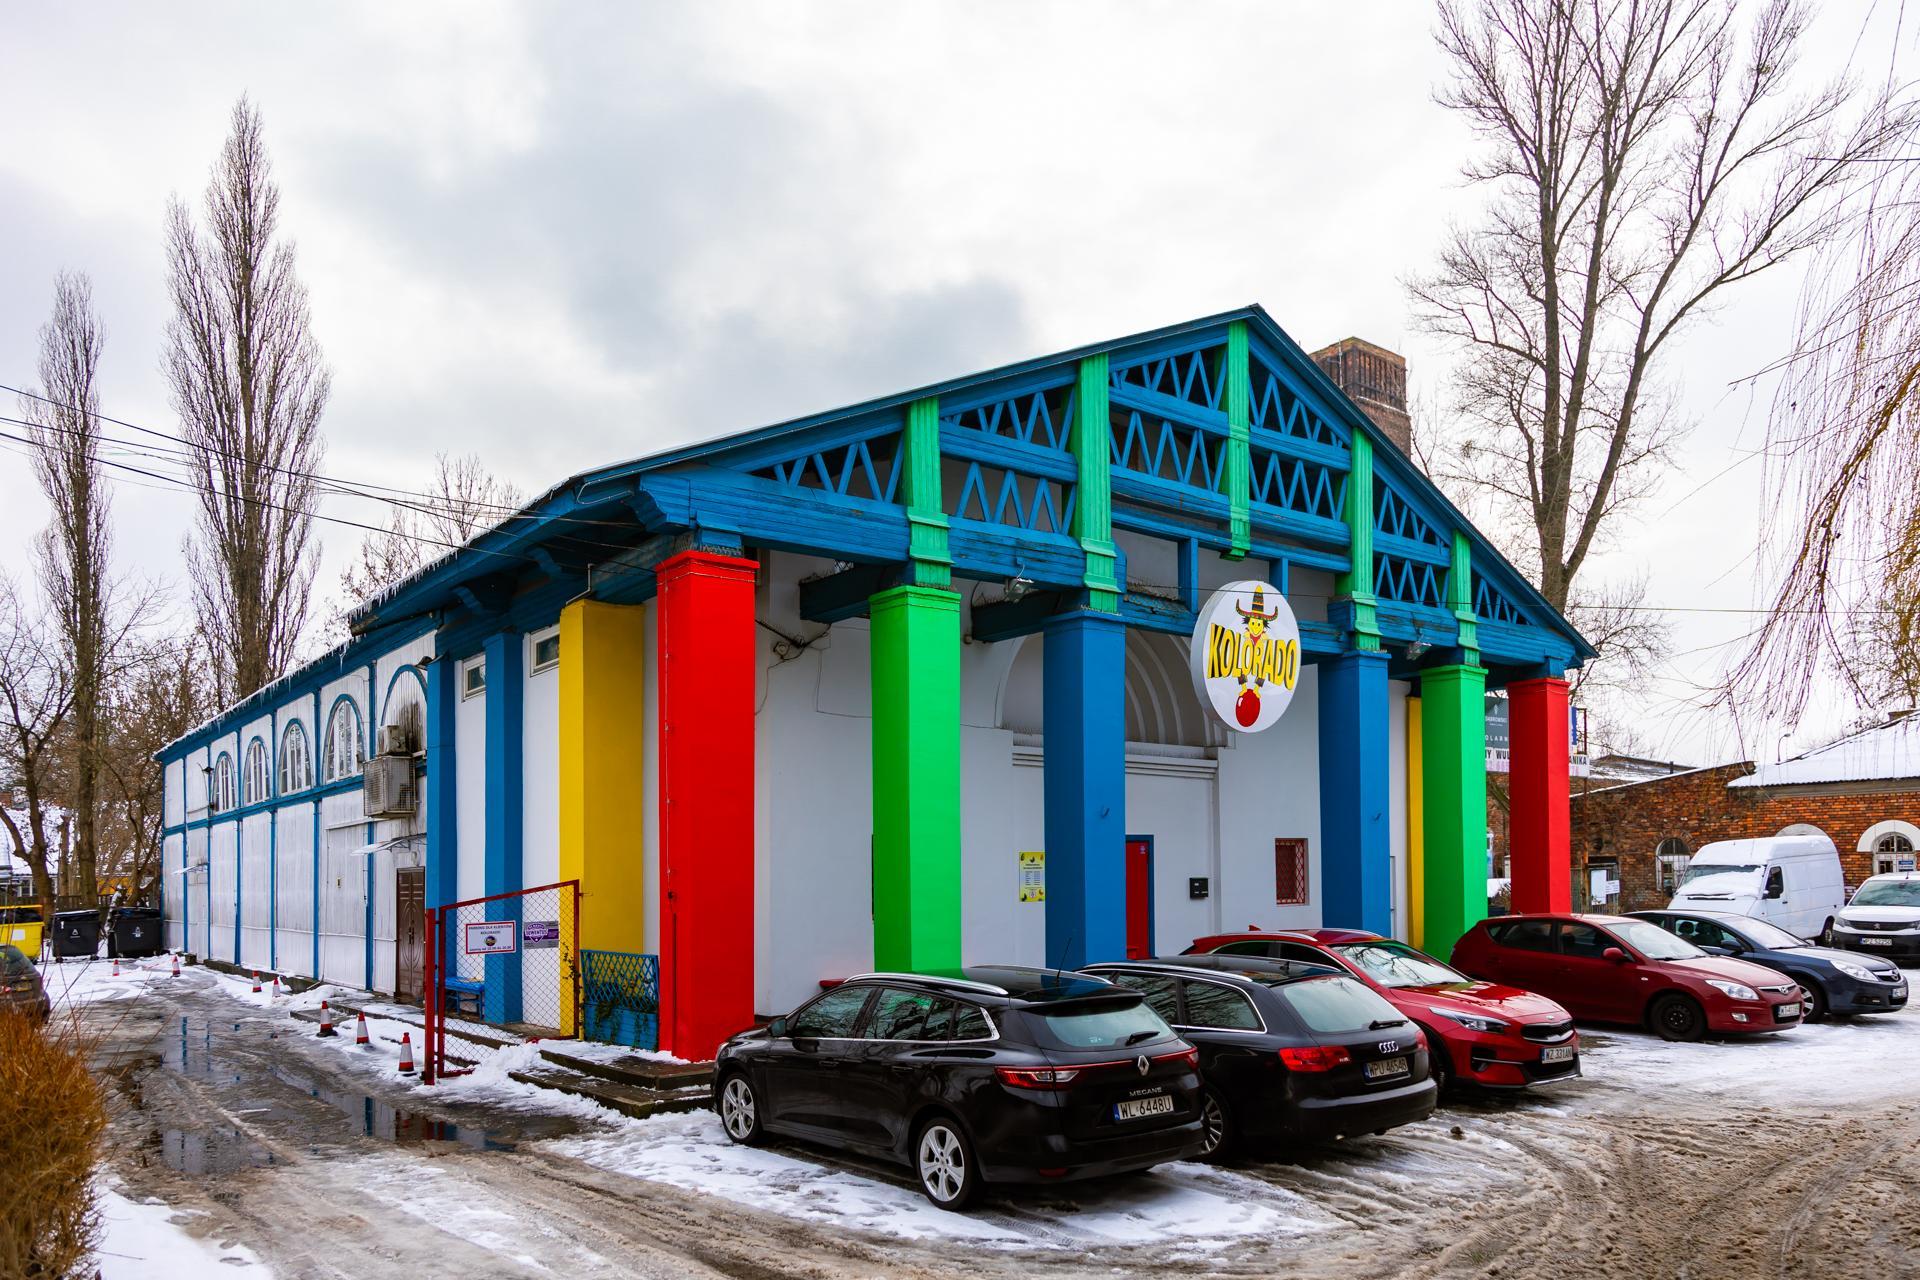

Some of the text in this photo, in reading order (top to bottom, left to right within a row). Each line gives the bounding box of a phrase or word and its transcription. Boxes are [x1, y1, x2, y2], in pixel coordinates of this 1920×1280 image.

[1207, 622, 1297, 691] KOLORADO
[1120, 1096, 1171, 1118] WL 6448U
